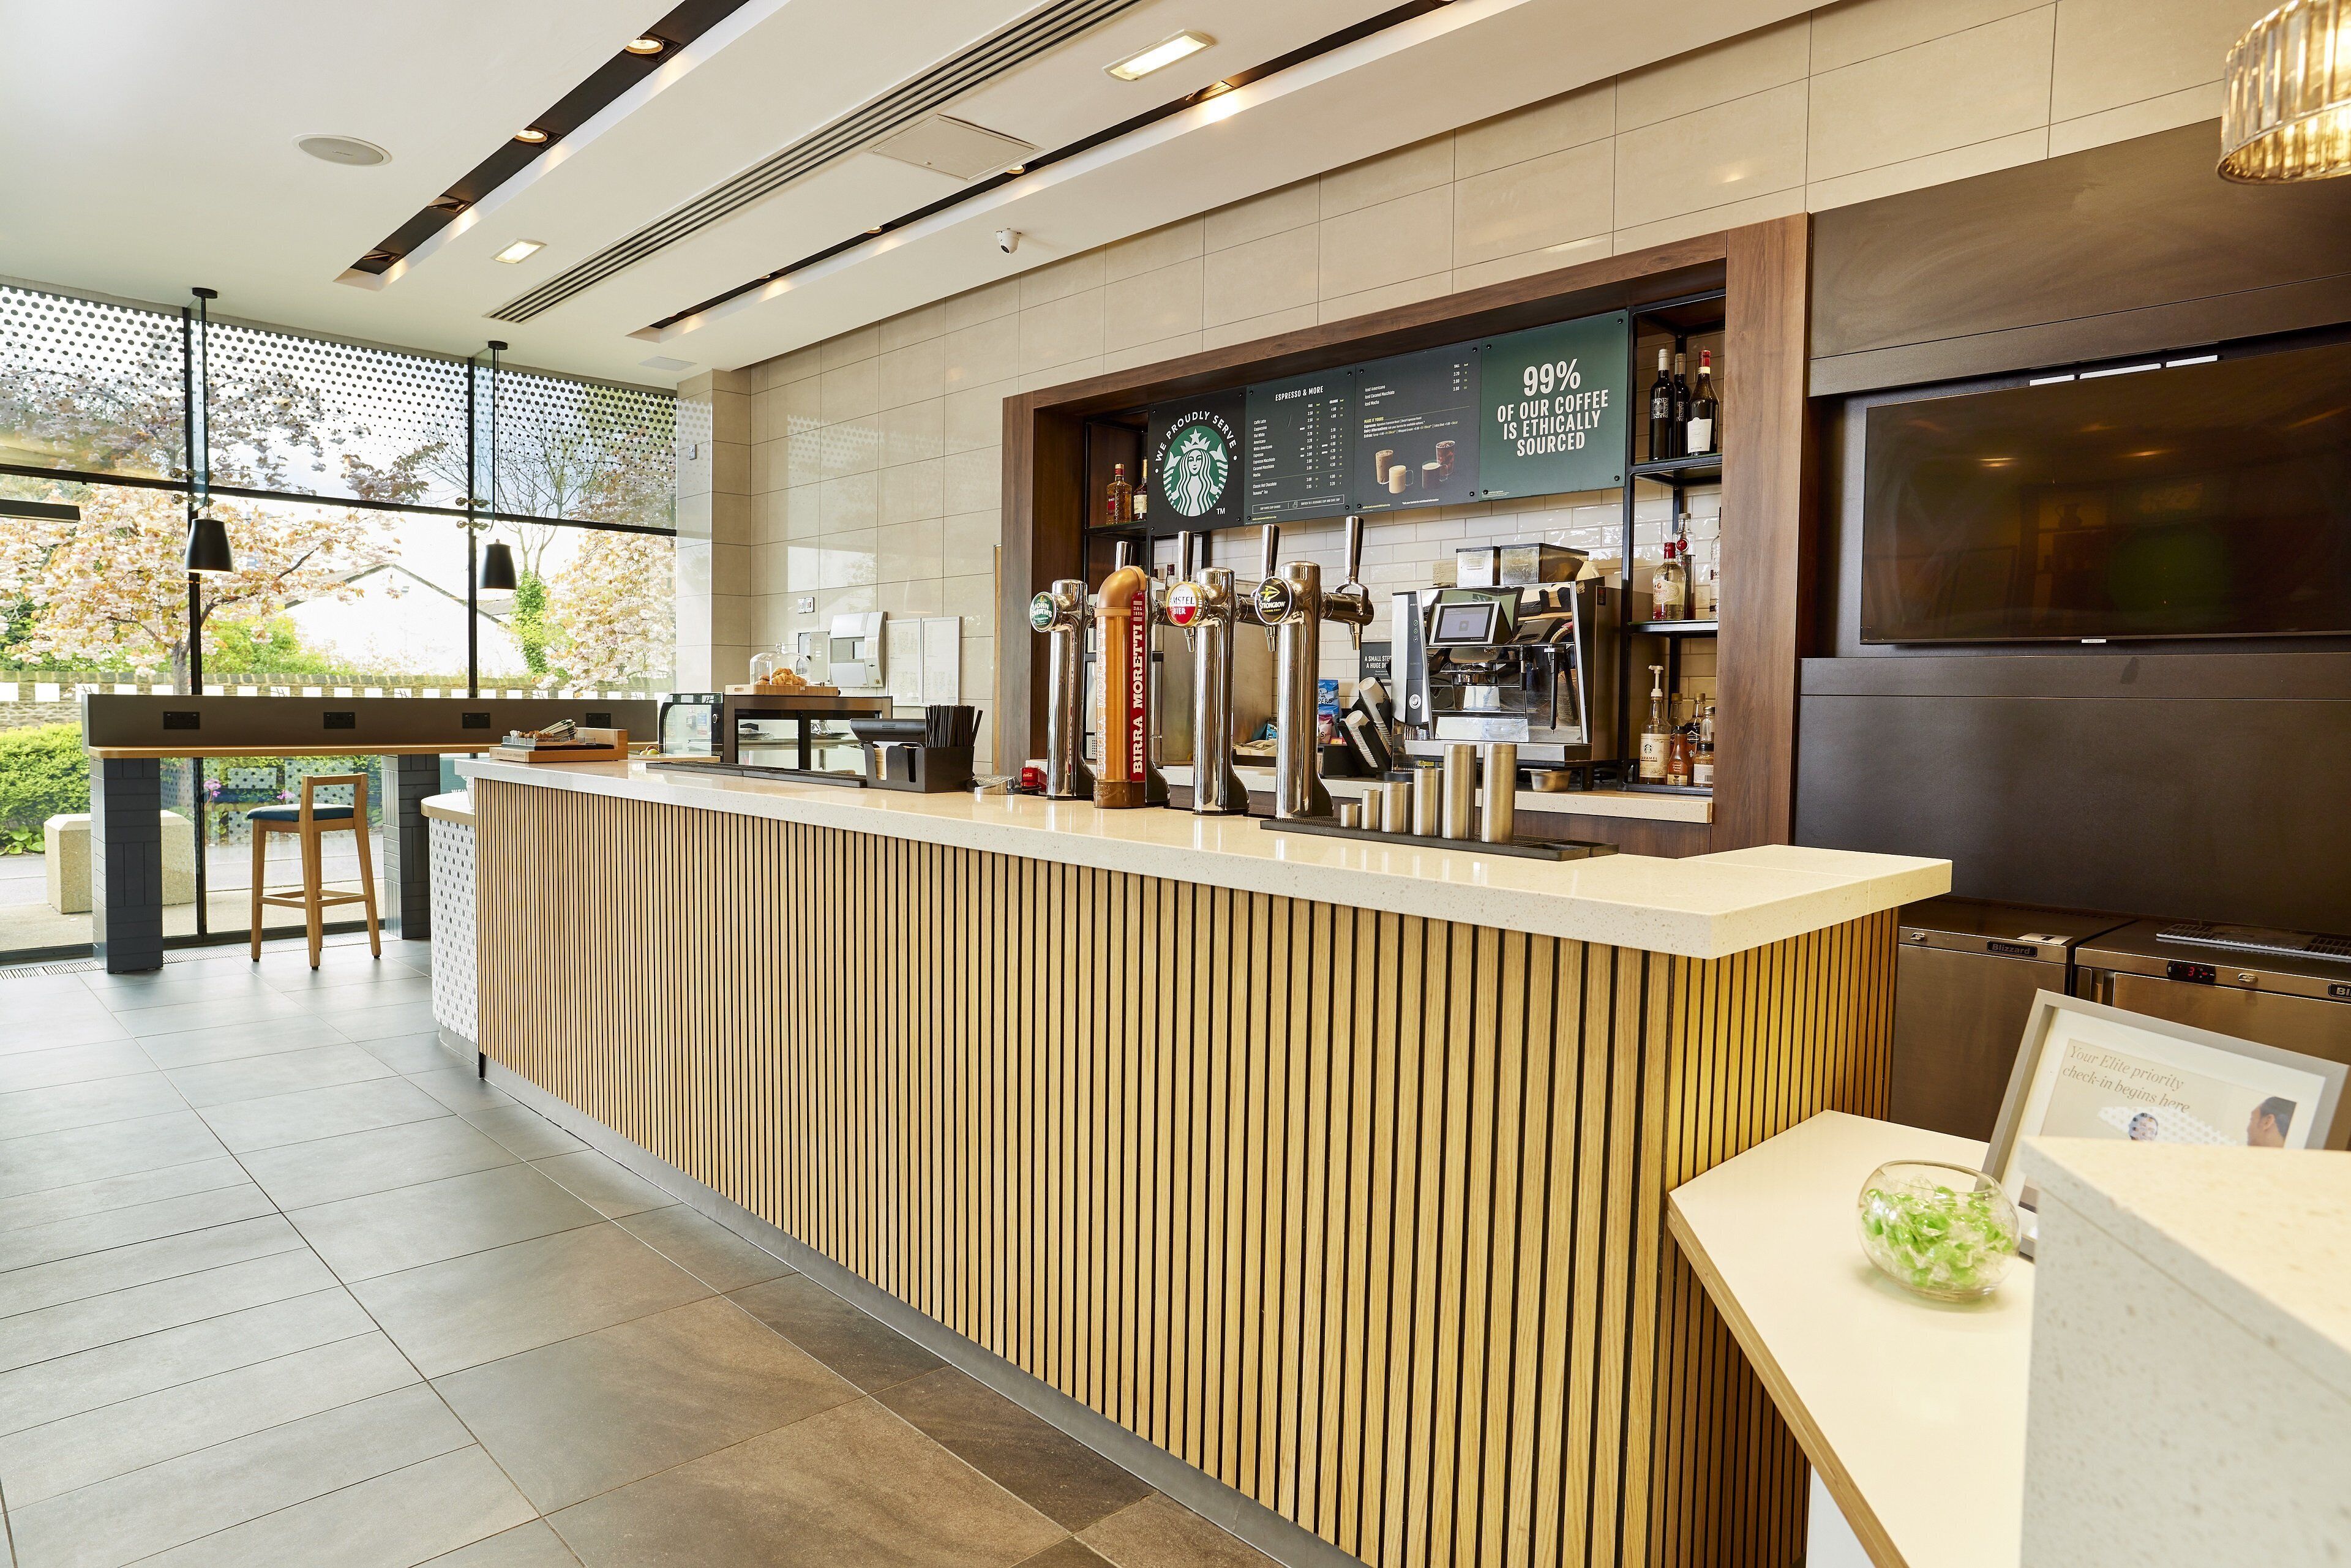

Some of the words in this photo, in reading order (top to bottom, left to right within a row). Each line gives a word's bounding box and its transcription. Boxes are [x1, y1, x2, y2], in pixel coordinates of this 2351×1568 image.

[1275, 391, 1301, 402] ESPRESSO
[1308, 386, 1324, 396] MORE
[1523, 358, 1581, 396] 99%
[1498, 404, 1515, 422] OF
[1520, 399, 1549, 419] OUR
[1554, 389, 1608, 414] COFFEE
[1155, 442, 1167, 462] WE
[1166, 410, 1210, 440] PROUDLY
[1212, 415, 1236, 449] SERVE
[1503, 422, 1517, 440] IS
[1523, 410, 1601, 438] ETHICALLY
[1517, 432, 1585, 457] SOURCED
[1259, 601, 1286, 610] STRONGBOW
[1133, 625, 1143, 709] MORETTI
[1133, 715, 1143, 774] BIRRA
[1992, 943, 2031, 955] Blizzard
[2069, 1046, 2099, 1065] Your
[2099, 1054, 2131, 1074] Elite
[2130, 1066, 2185, 1092] priority
[2062, 1065, 2113, 1089] check-in
[2114, 1079, 2158, 1105] begins
[2159, 1092, 2191, 1113] here
